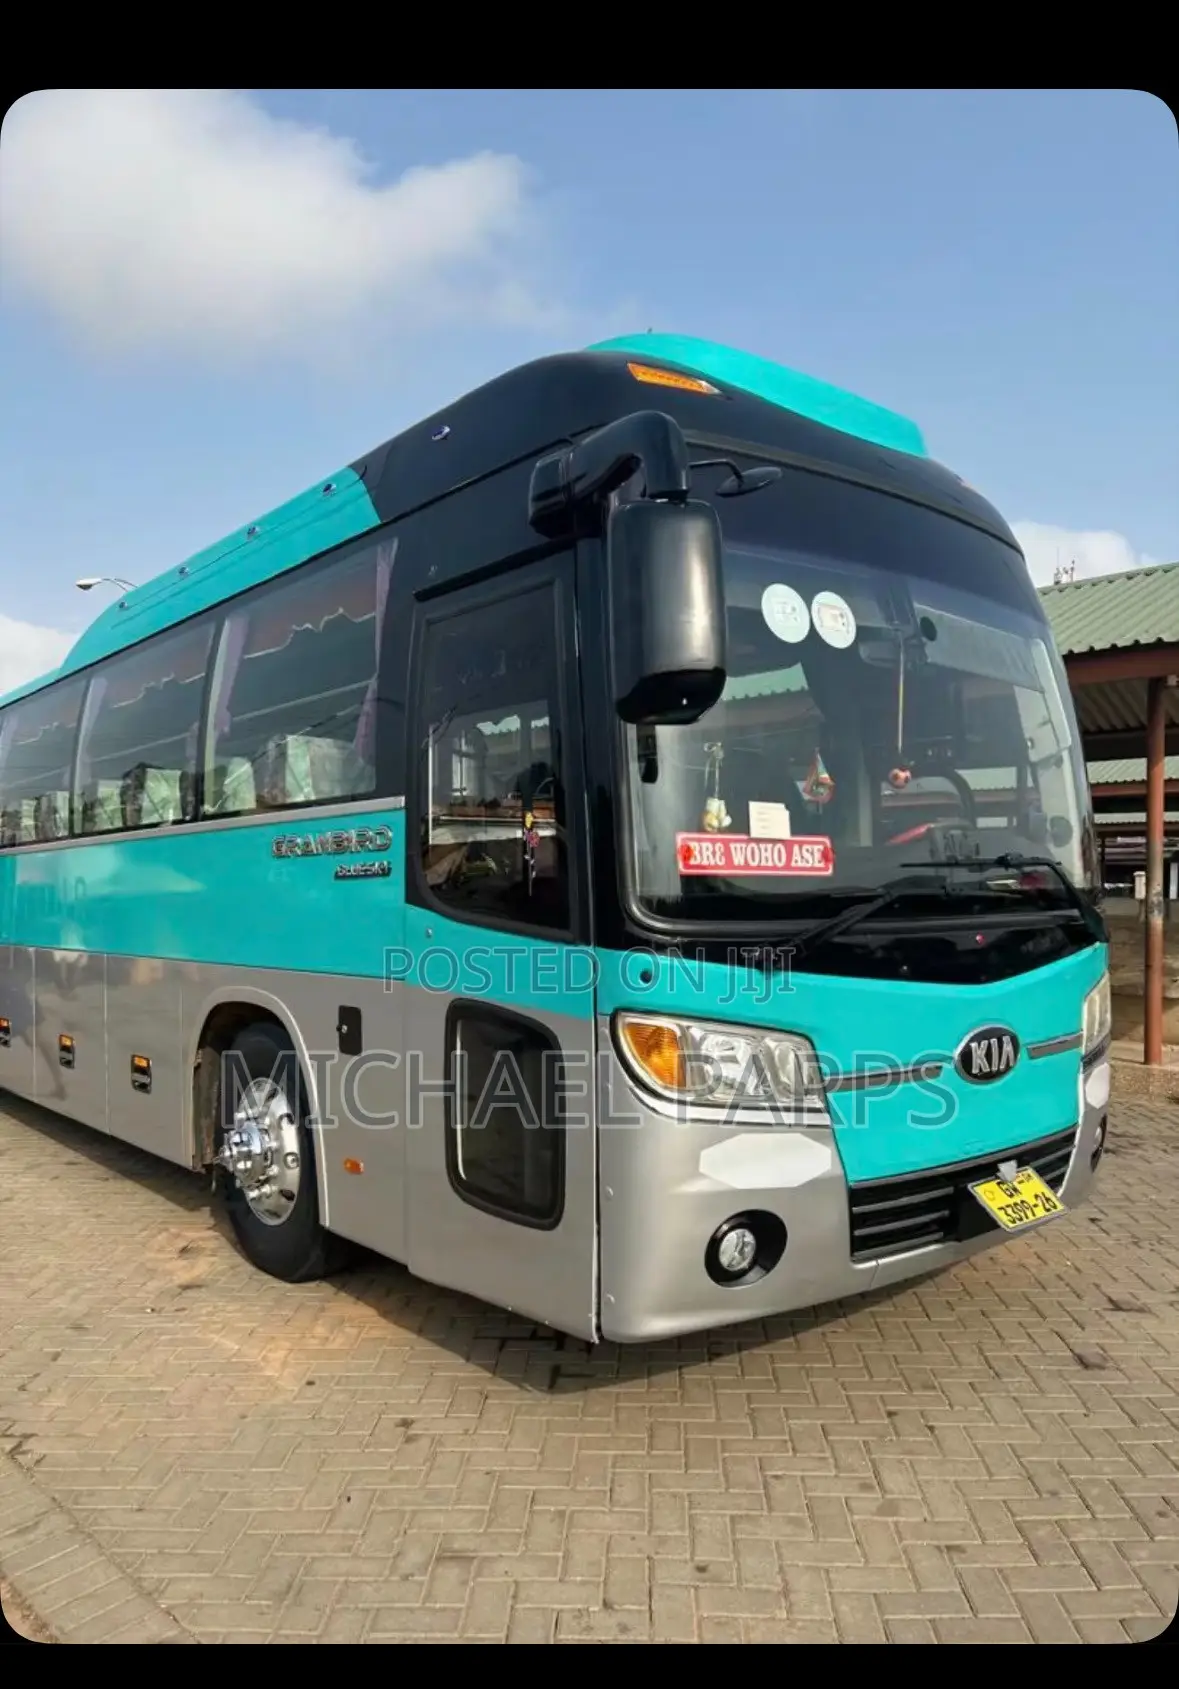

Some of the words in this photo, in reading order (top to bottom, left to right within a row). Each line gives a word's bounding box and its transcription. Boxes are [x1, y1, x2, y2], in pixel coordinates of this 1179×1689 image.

[272, 825, 393, 857] GRANBIRD
[730, 842, 786, 867] WOHO
[791, 844, 825, 868] ASE
[970, 1035, 1014, 1074] KIA
[997, 1191, 1058, 1225] 3399-26
